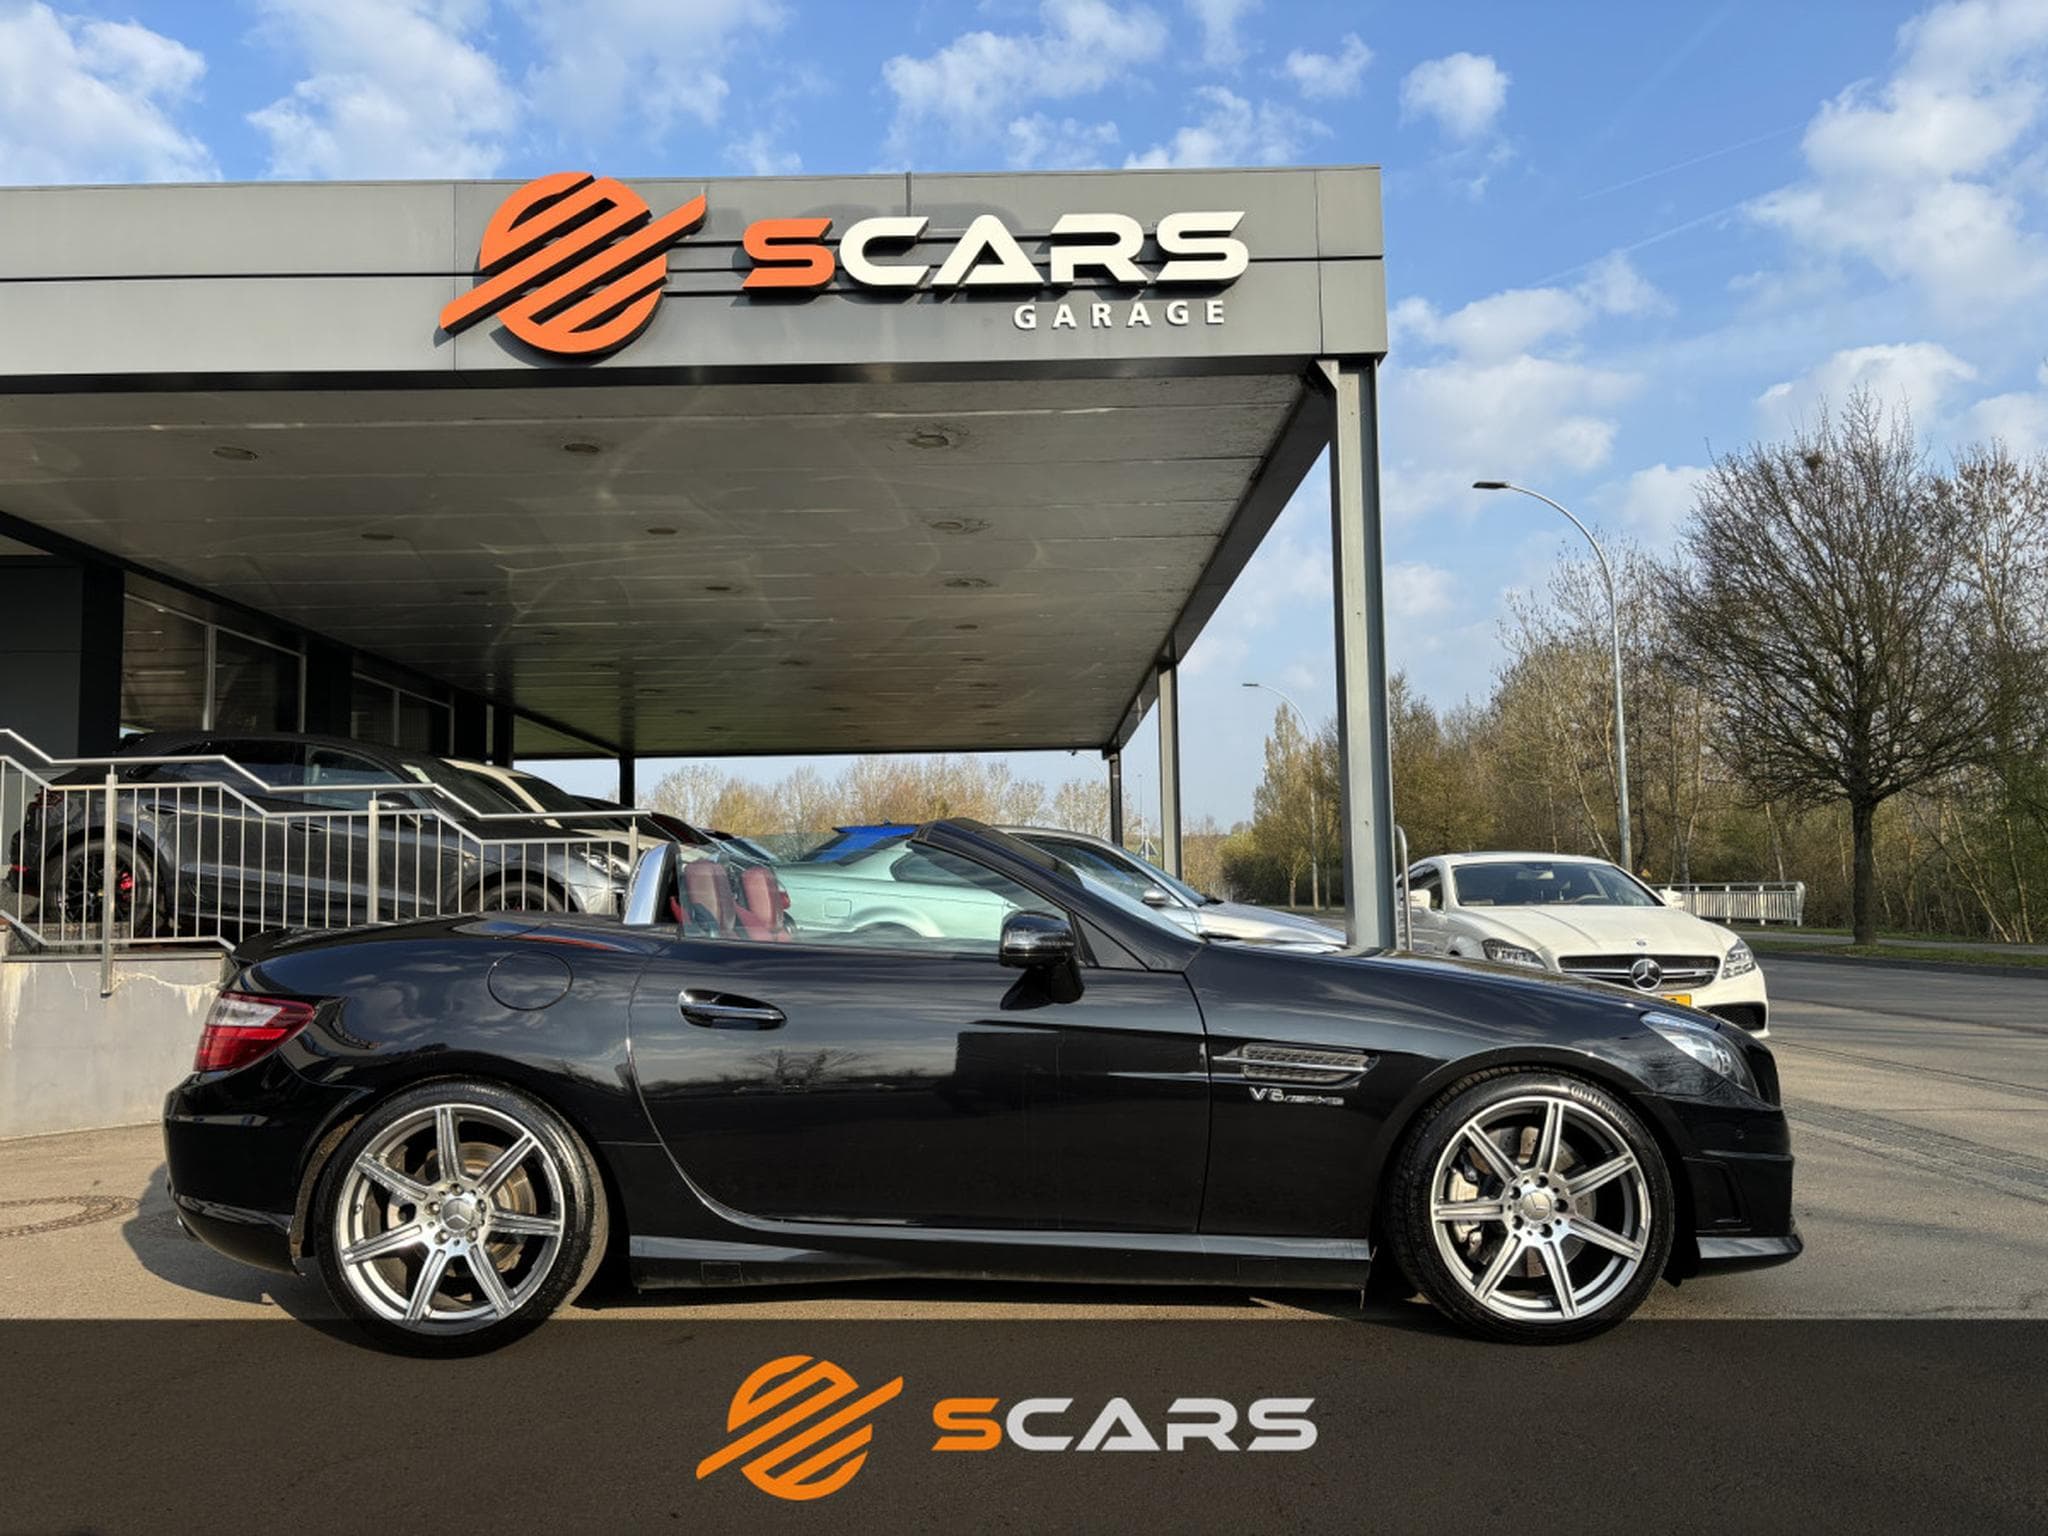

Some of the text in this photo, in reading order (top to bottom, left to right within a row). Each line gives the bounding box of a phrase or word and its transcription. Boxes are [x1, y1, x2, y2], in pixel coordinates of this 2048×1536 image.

[742, 211, 1250, 289] SCARS
[1014, 299, 1226, 330] GARAGE
[1249, 1086, 1285, 1102] V8
